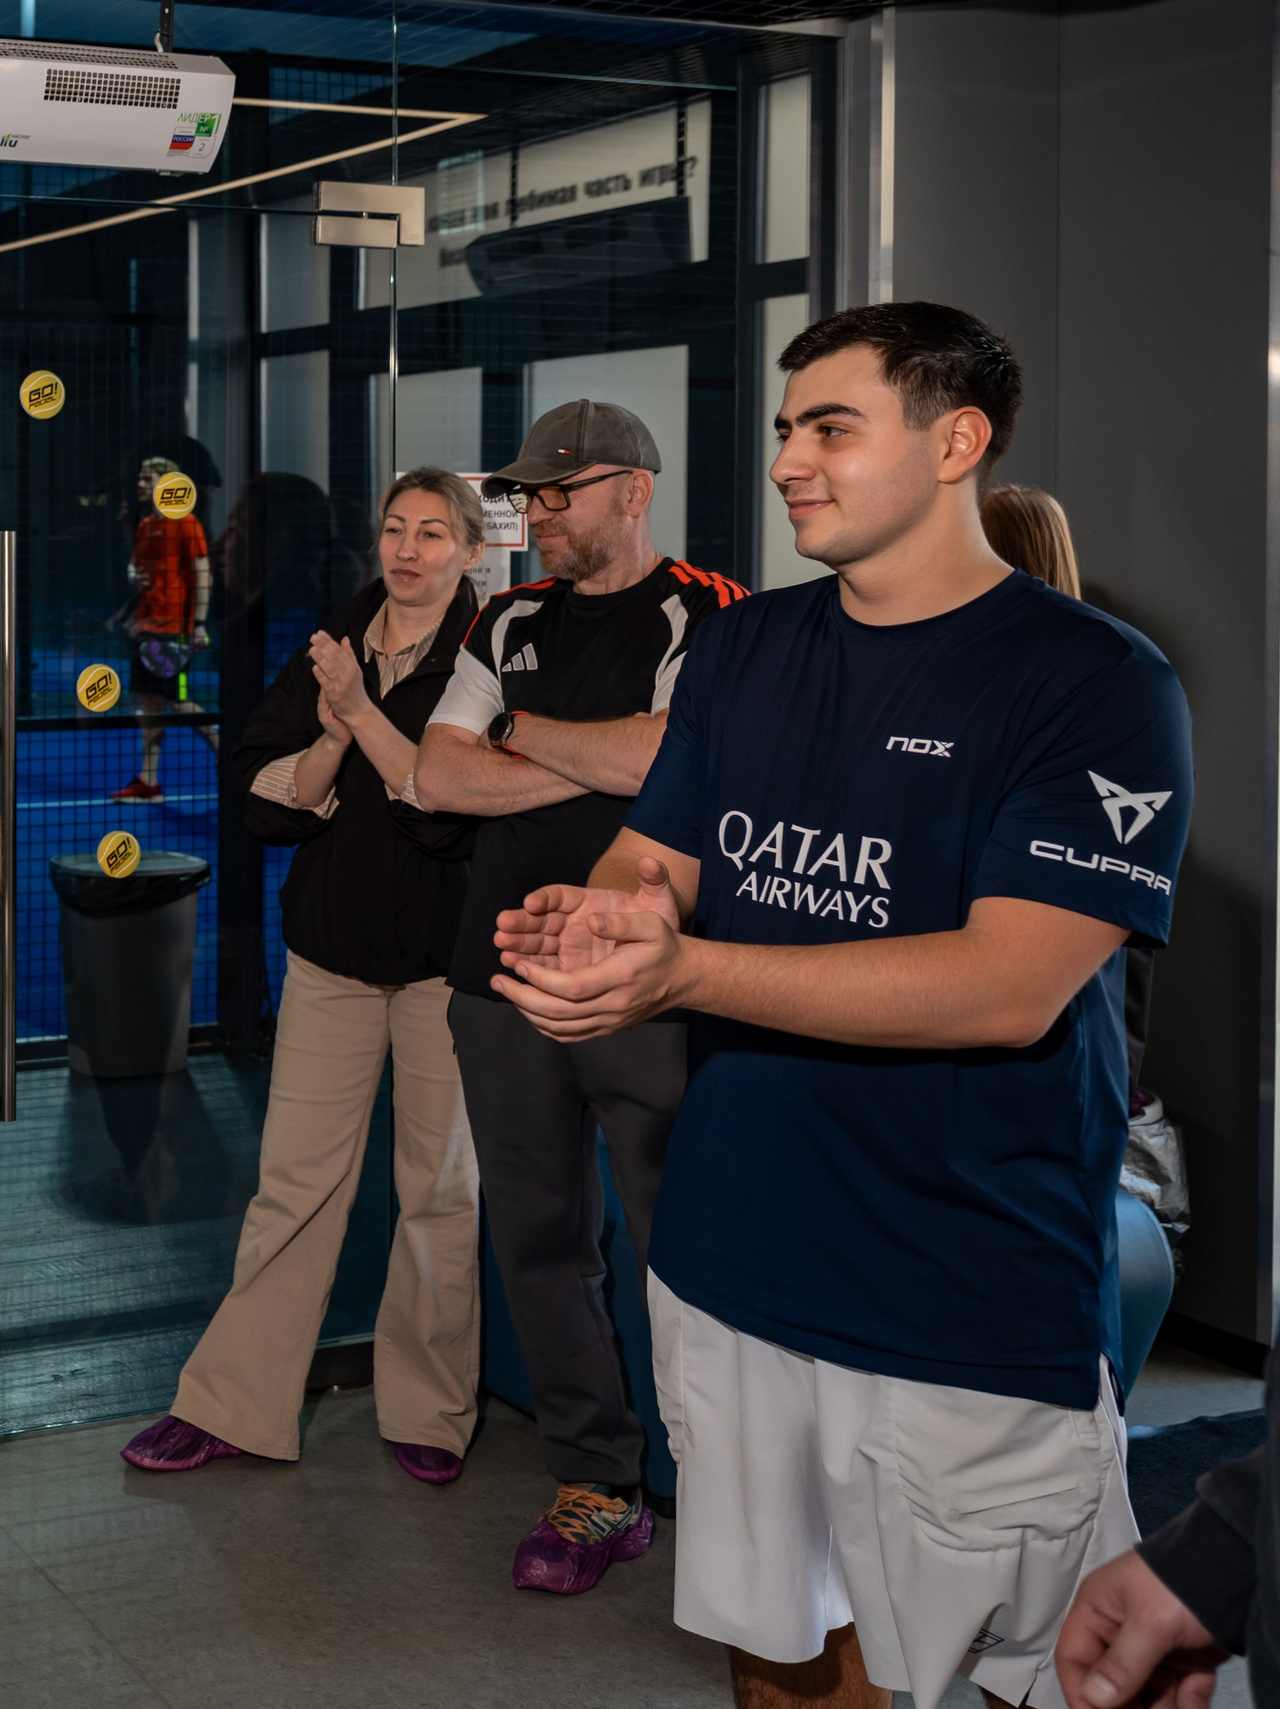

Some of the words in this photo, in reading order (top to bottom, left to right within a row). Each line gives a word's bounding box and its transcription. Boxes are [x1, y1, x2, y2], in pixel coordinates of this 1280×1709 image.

[177, 113, 211, 124] ЛИДЕР
[198, 143, 206, 151] 2
[29, 382, 58, 403] GO!
[160, 487, 191, 500] GO!
[483, 509, 518, 519] МЕННОЙ
[86, 672, 112, 700] GO!
[106, 836, 132, 868] GO!
[719, 810, 892, 890] QATAR
[1030, 840, 1172, 896] CUPRA
[736, 871, 890, 928] AIRWAYS
